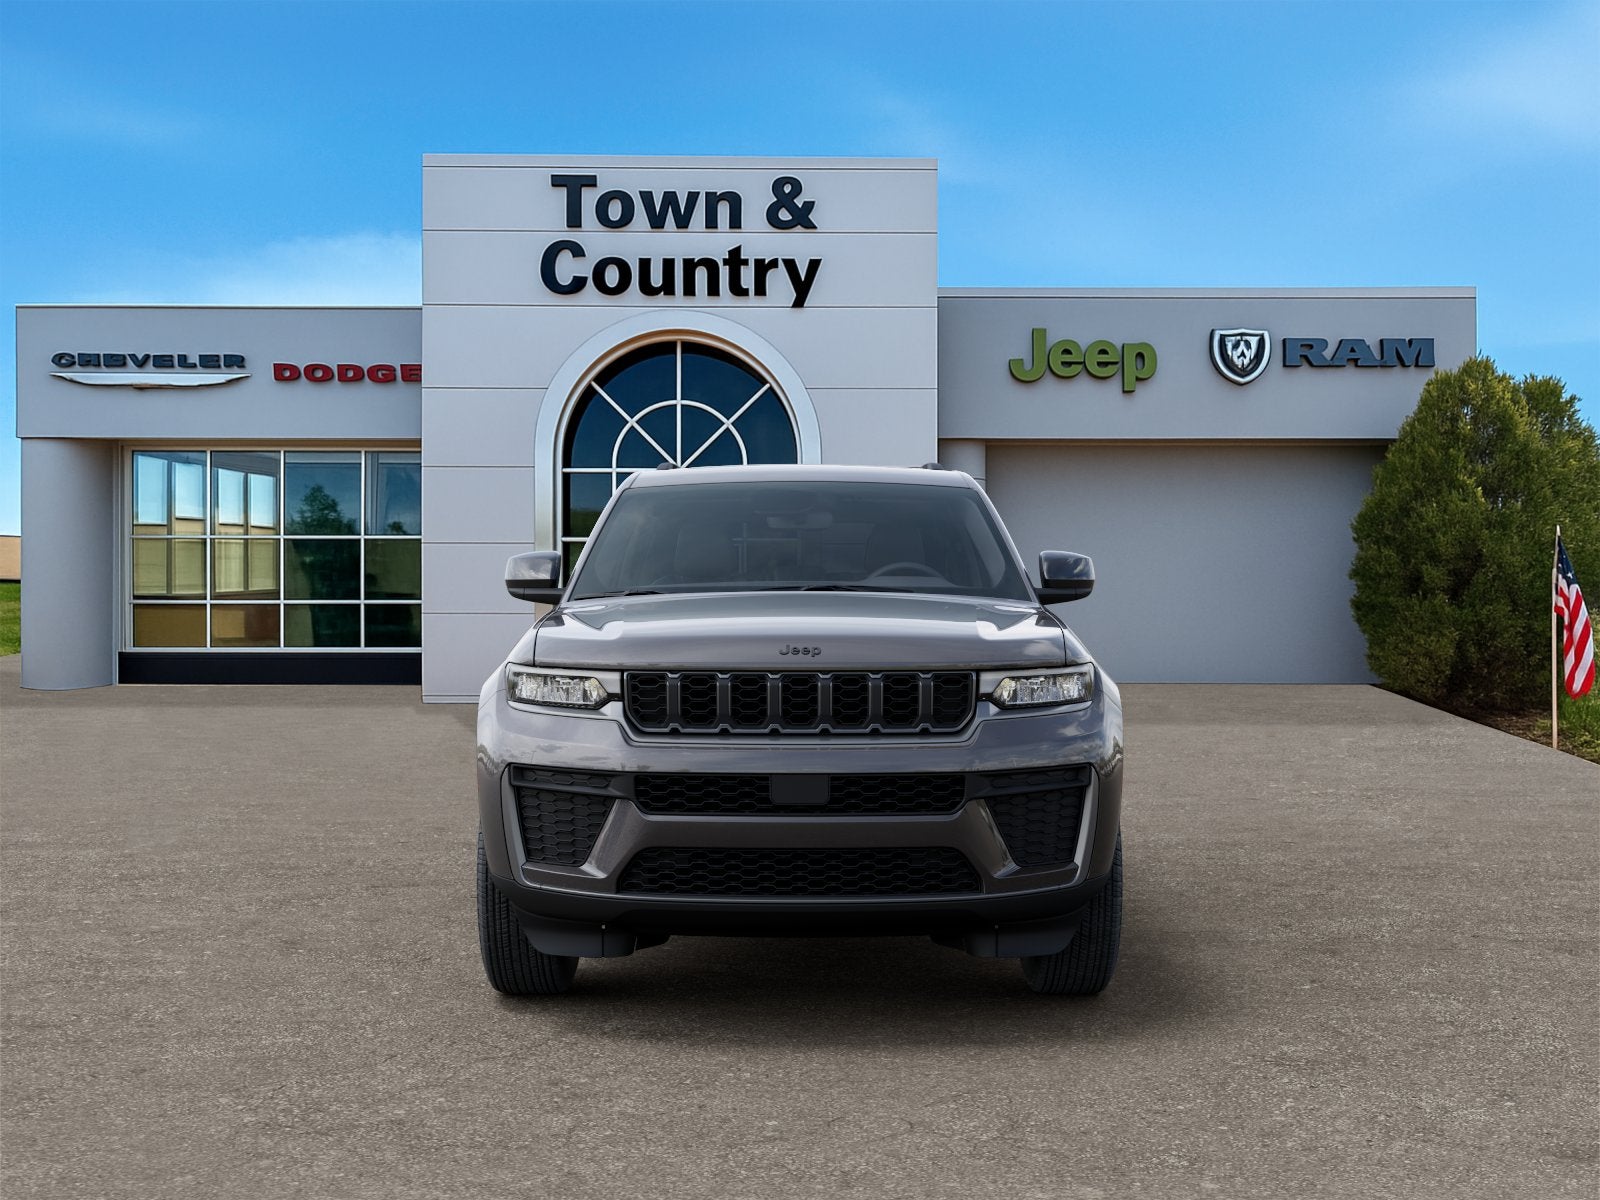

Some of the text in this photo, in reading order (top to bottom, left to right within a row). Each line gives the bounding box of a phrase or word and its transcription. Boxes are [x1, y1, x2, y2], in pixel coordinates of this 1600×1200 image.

[550, 174, 818, 230] Town &
[540, 239, 822, 308] Country
[273, 363, 422, 383] DODGE
[1009, 328, 1157, 393] Jeep
[1283, 337, 1435, 368] RAM
[779, 644, 822, 657] Jeep
